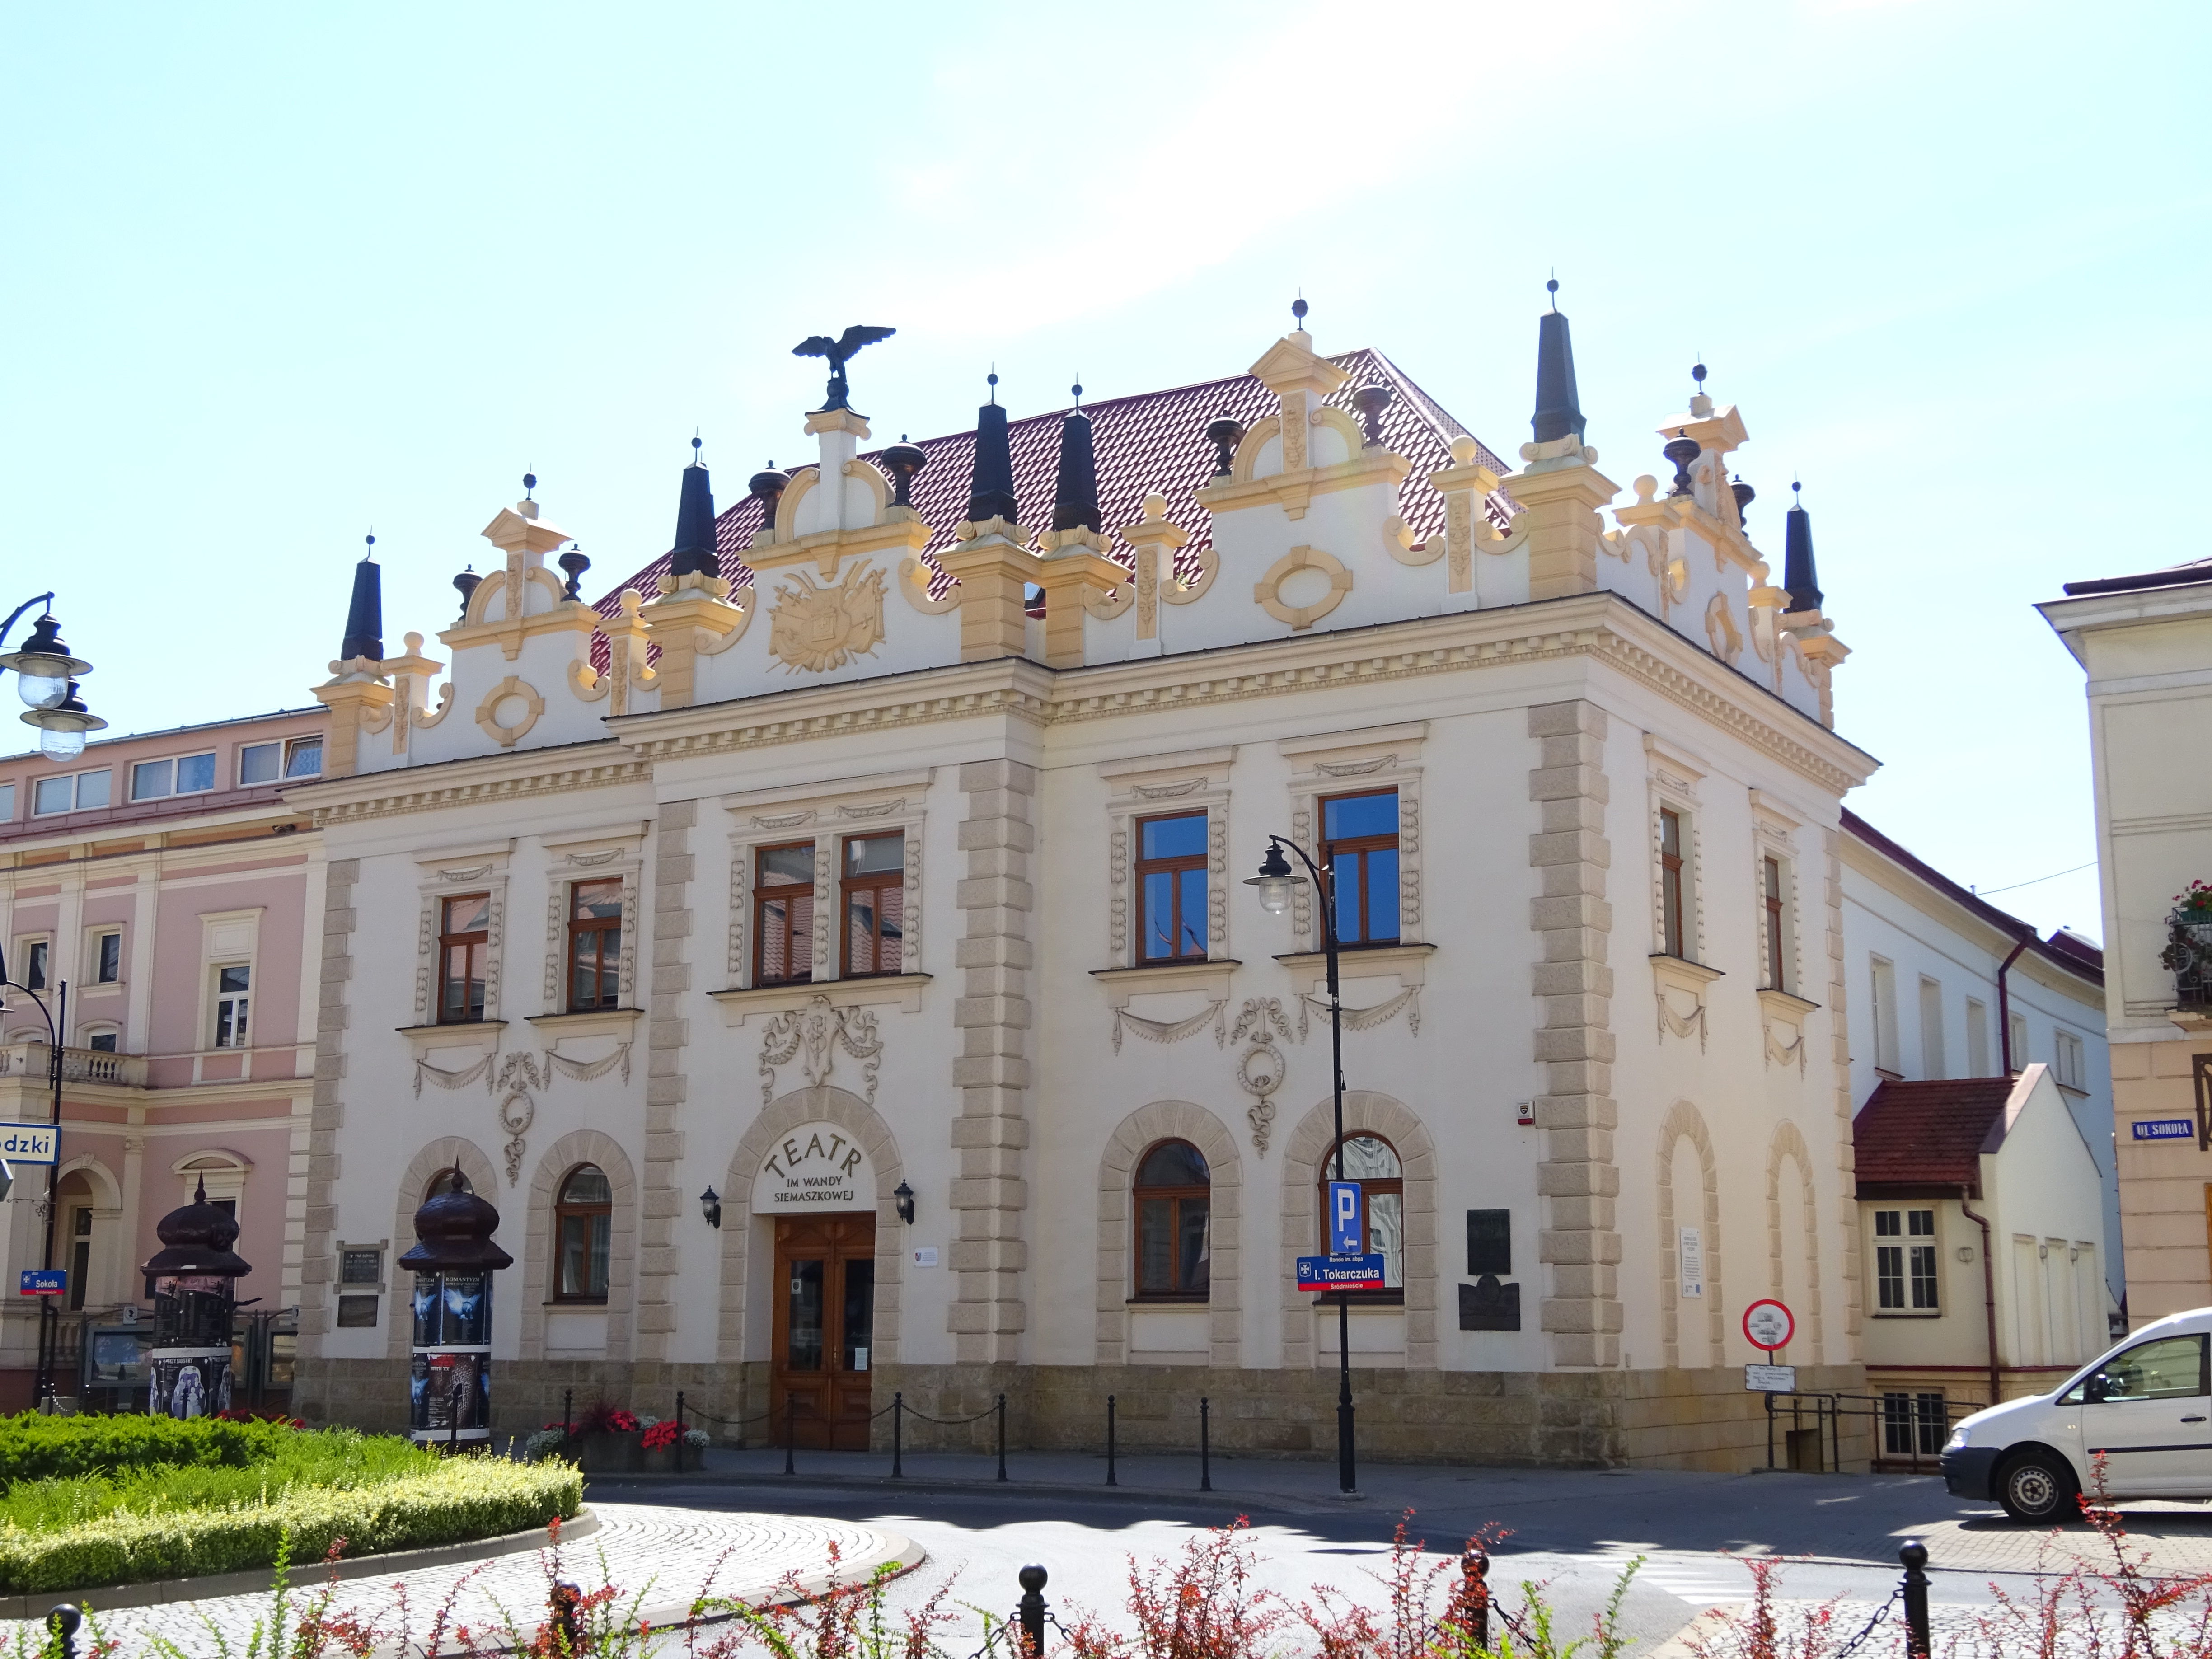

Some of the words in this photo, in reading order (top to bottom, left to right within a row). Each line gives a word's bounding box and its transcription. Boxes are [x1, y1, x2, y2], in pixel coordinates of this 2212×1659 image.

[2152, 1123, 2189, 1135] SOKOŁA
[0, 1134, 49, 1153] dzki
[764, 1132, 862, 1178] TEATR
[787, 1178, 799, 1187] IM
[803, 1176, 843, 1187] WANDY
[774, 1190, 853, 1202] SIEMASZKOWEJ
[1337, 1189, 1355, 1232] P
[1322, 1267, 1380, 1280] Tokarczuka
